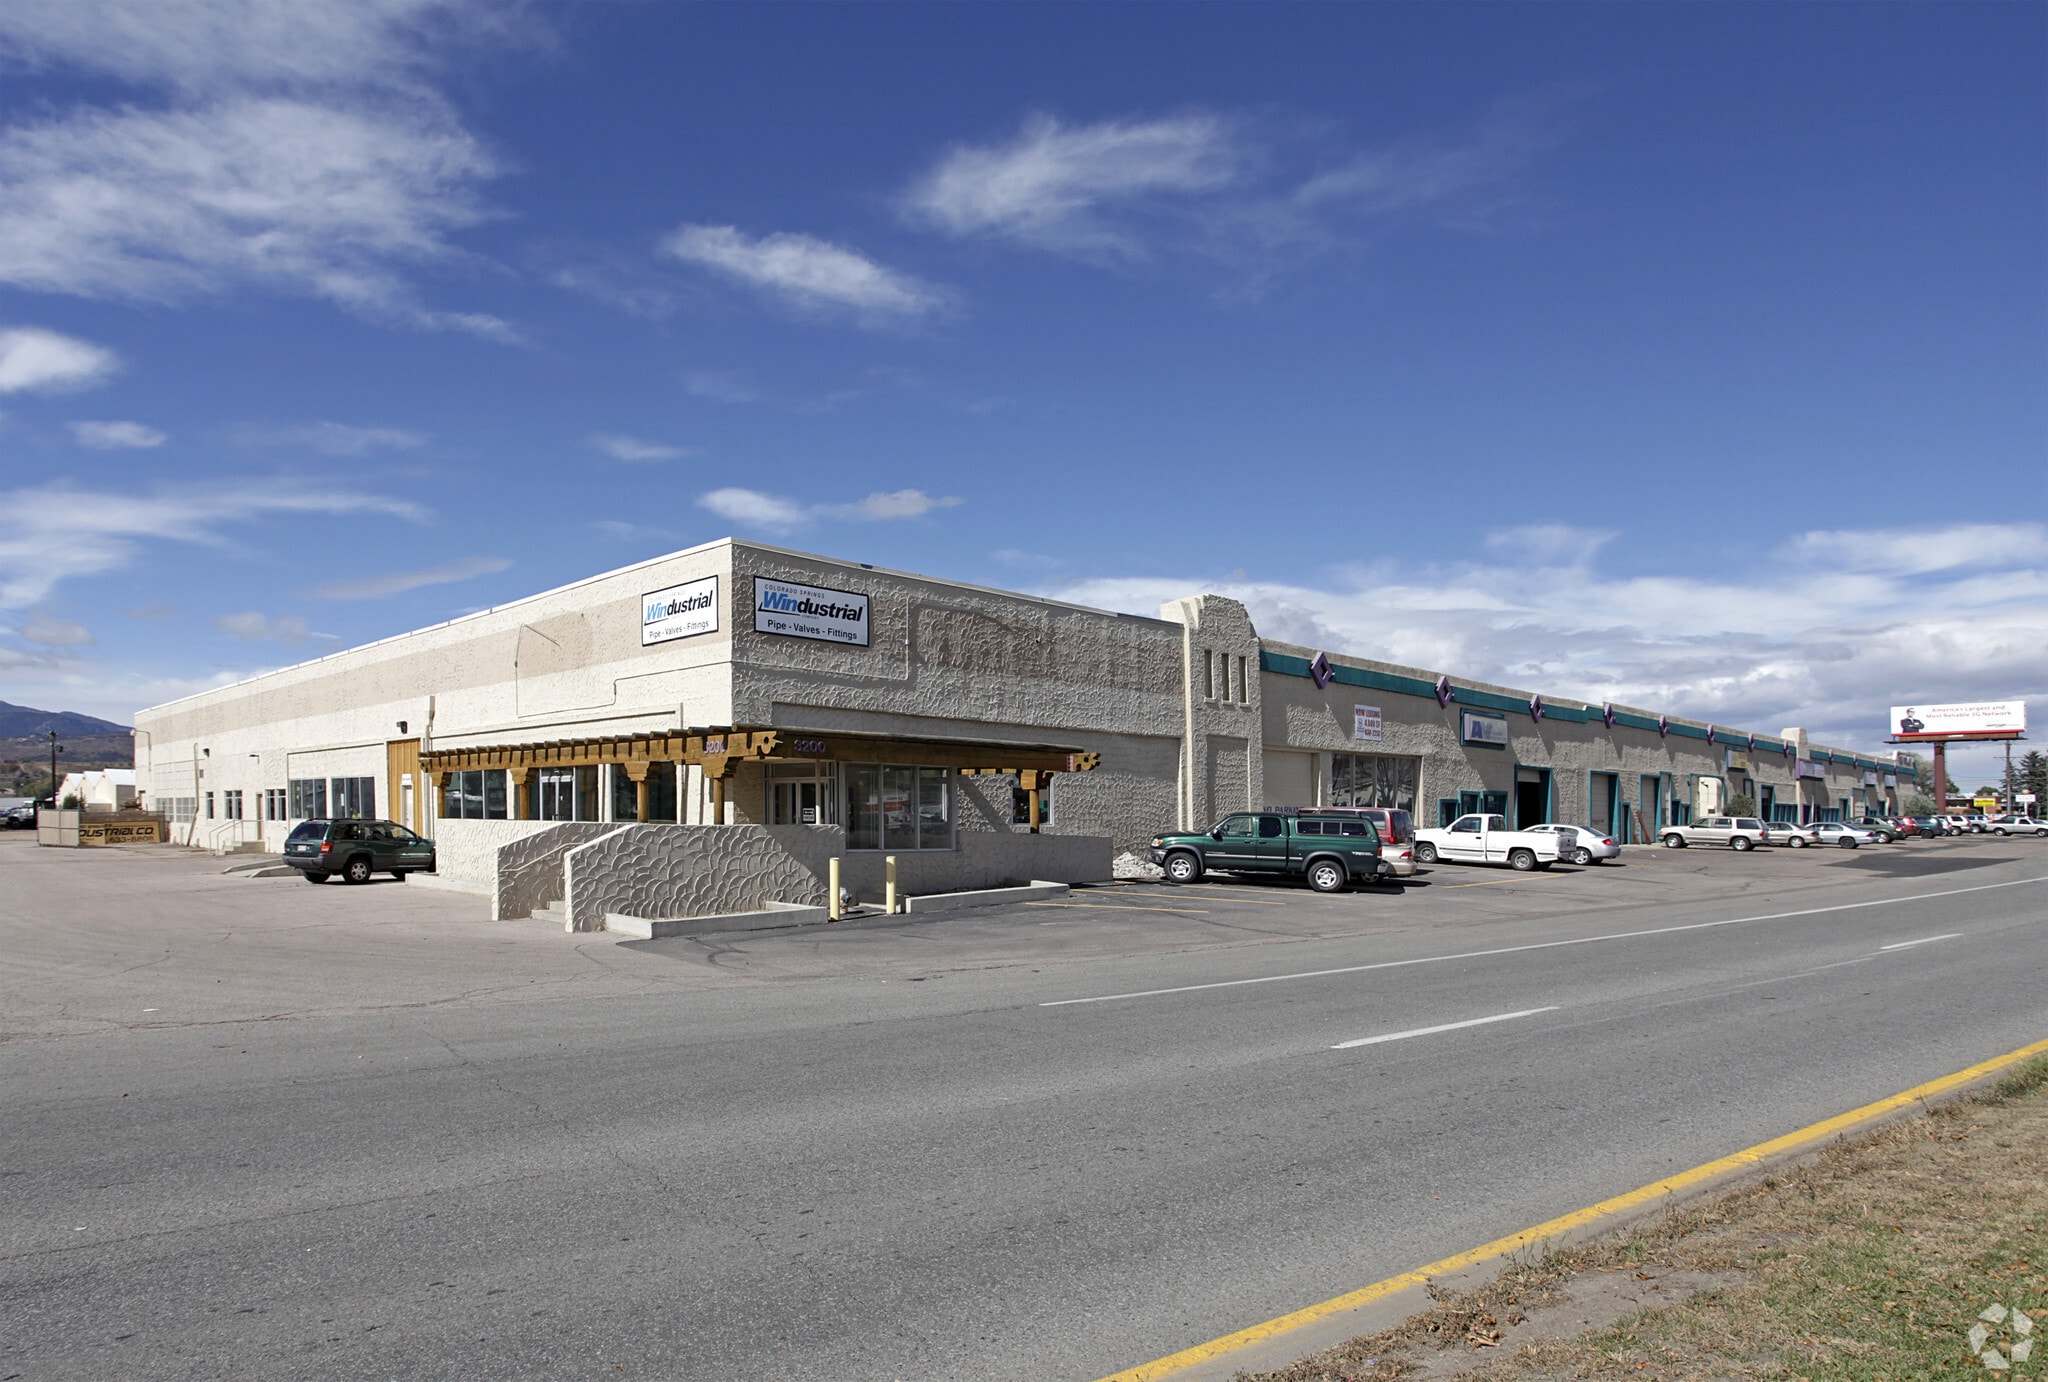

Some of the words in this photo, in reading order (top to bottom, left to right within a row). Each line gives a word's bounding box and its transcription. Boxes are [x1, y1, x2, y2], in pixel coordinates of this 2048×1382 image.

[764, 584, 798, 594] COLORADO
[799, 590, 825, 599] SPRINGS
[647, 590, 713, 621] Windustrial
[763, 591, 863, 622] Windustrial
[649, 630, 661, 639] Pipe
[665, 626, 682, 636] Valves
[687, 620, 709, 631] Fittings
[767, 619, 787, 631] Pipe
[793, 623, 821, 635] Valves
[827, 628, 857, 641] Fittings
[794, 739, 826, 753] 3200
[1275, 805, 1299, 813] PARKI
